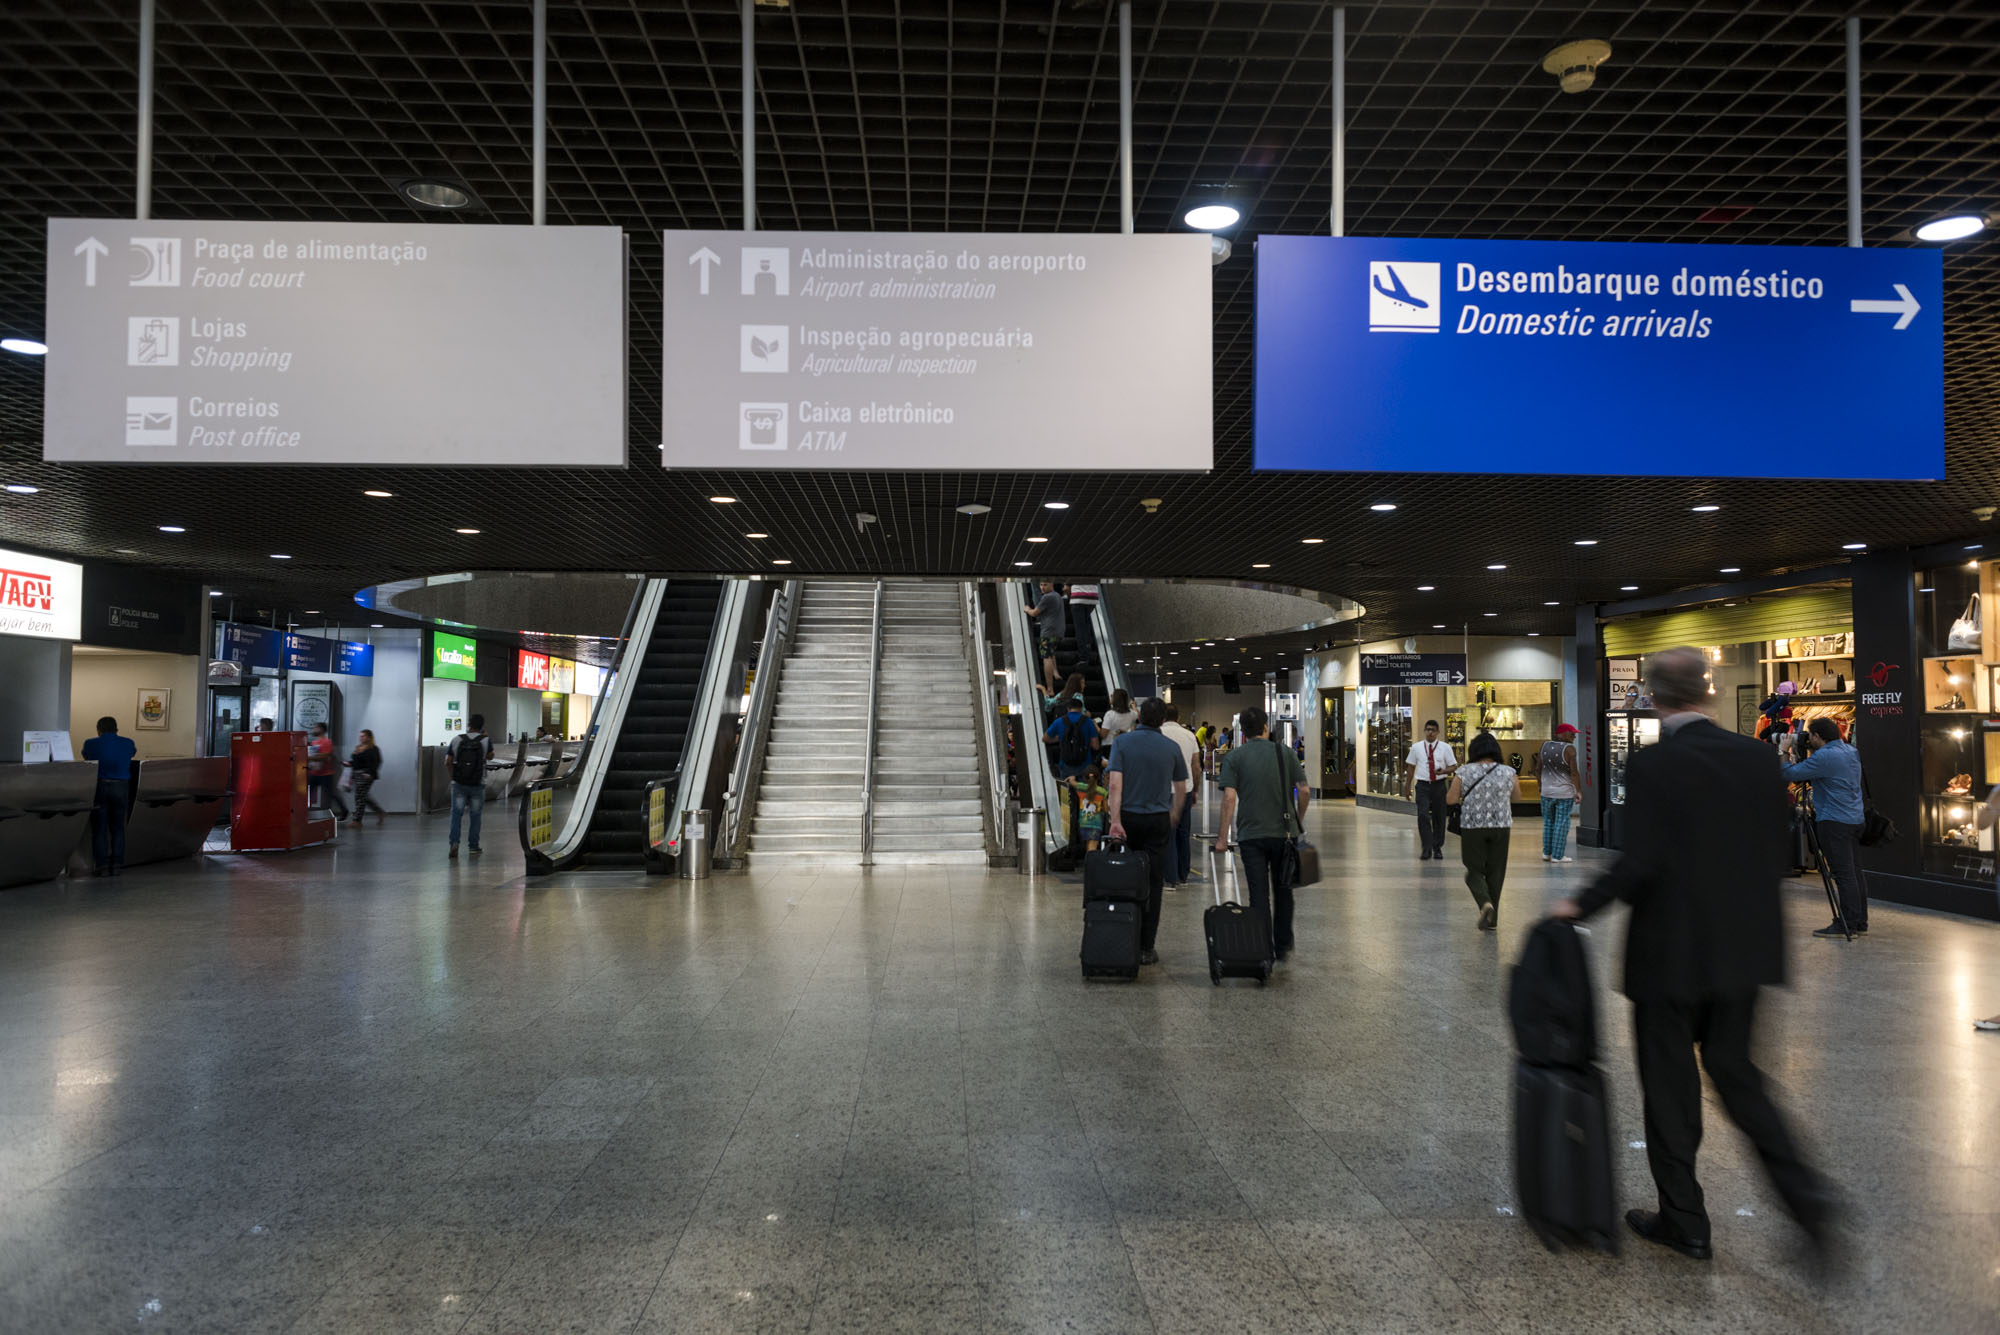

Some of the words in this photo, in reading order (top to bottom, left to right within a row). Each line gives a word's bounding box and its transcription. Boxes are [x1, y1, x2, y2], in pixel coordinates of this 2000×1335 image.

[195, 238, 254, 263] Praça
[263, 239, 288, 259] de
[296, 239, 428, 265] alimentação
[799, 248, 949, 274] Administração
[956, 250, 980, 270] do
[988, 253, 1087, 274] aeroporto
[191, 267, 245, 288] Food
[249, 271, 305, 288] court
[799, 277, 865, 302] Airport
[870, 277, 997, 299] administration
[1456, 263, 1660, 302] Desembarque
[1671, 268, 1825, 299] doméstico
[191, 317, 247, 342] Lojas
[1456, 304, 1596, 337] Domestic
[1602, 308, 1713, 339] arrivals
[800, 325, 892, 351] Inspeção
[899, 327, 1033, 352] agropecuária
[190, 345, 293, 372] Shopping
[800, 352, 895, 377] Agricultural
[897, 354, 977, 378] inspection
[189, 397, 280, 419] Correios
[798, 401, 852, 423] Caixa
[859, 402, 954, 424] eletrônico
[188, 426, 237, 447] Post
[240, 426, 301, 448] office
[797, 430, 847, 452] ATM
[522, 655, 545, 687] AVIS
[1862, 693, 1885, 705] FREE
[1886, 692, 1902, 704] FLY
[1870, 706, 1904, 718] express
